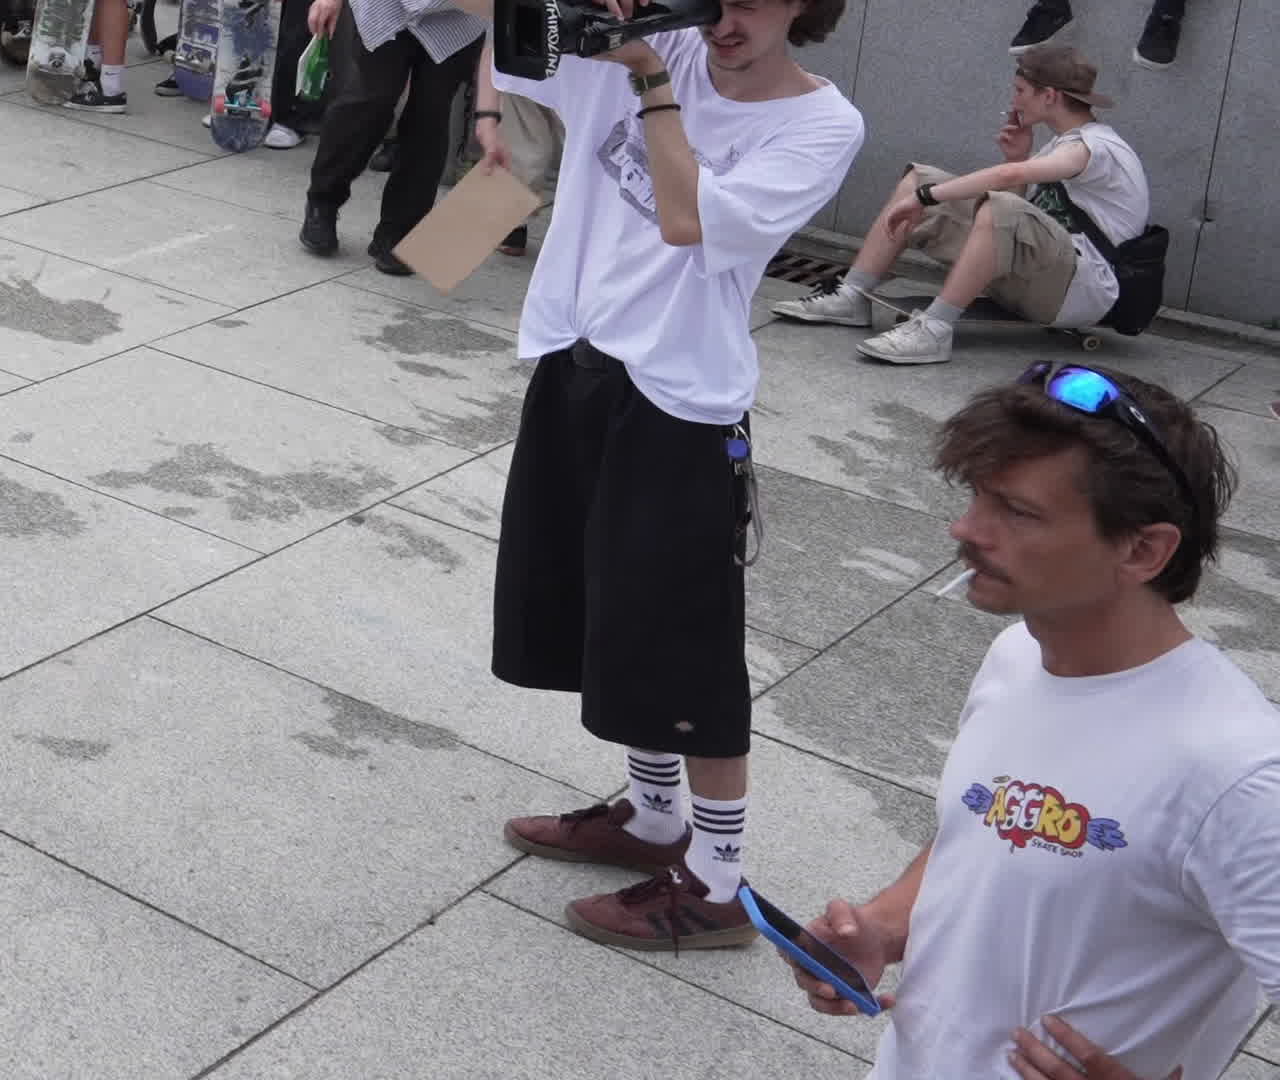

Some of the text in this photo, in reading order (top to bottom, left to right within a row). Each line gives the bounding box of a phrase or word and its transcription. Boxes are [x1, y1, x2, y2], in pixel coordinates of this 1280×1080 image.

[983, 784, 1082, 844] AGGRO
[1031, 837, 1085, 858] SKATE SHOP
